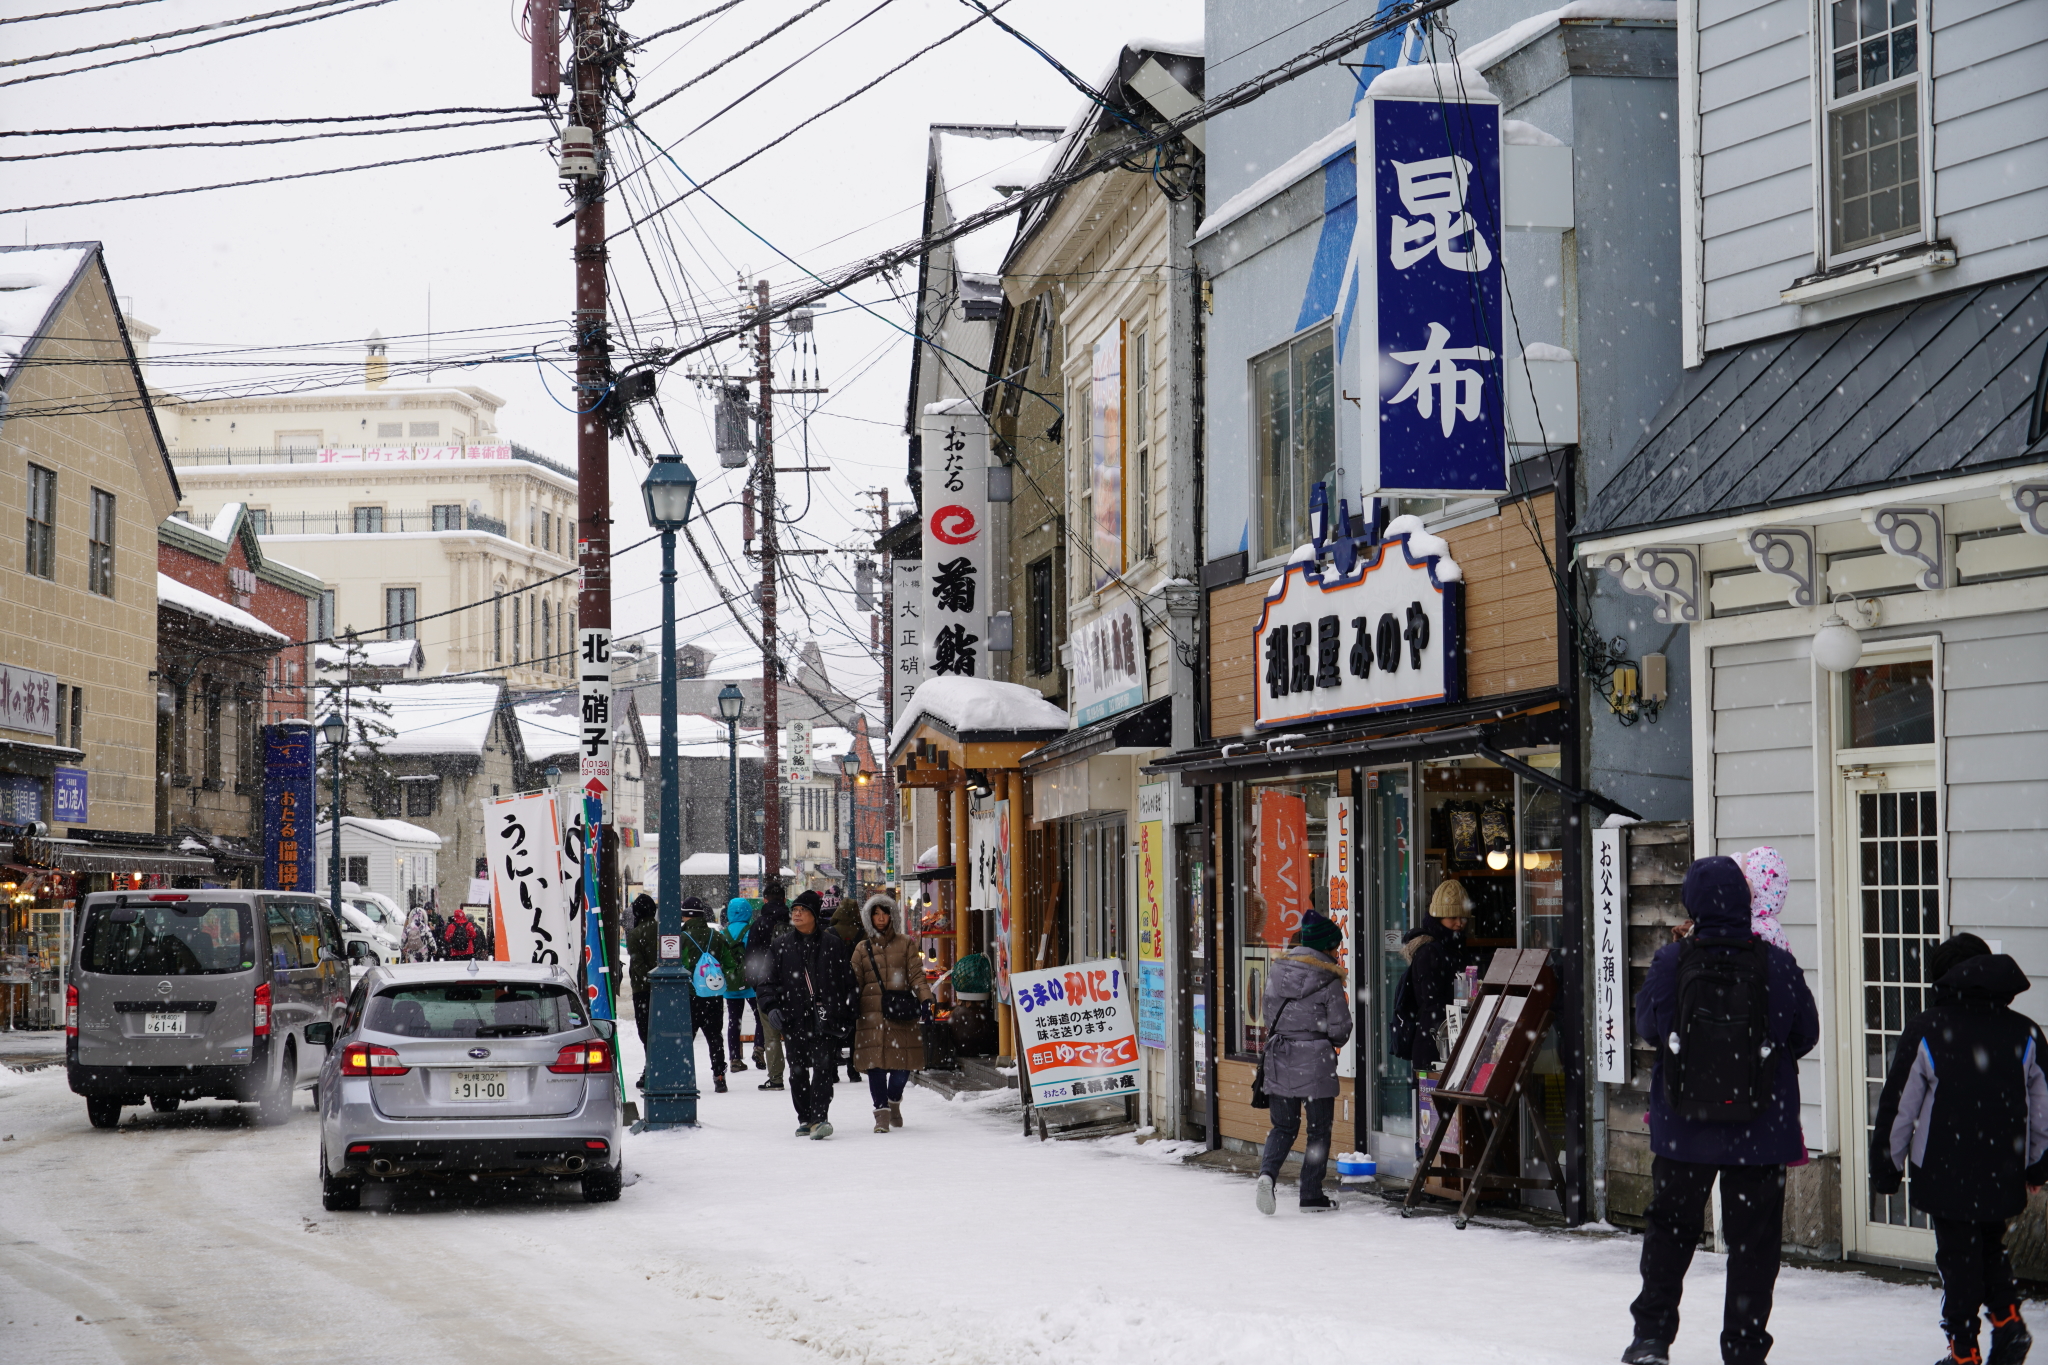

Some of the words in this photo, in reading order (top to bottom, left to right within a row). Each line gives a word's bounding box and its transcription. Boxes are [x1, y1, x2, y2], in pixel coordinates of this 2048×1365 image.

[1387, 154, 1496, 438] 昆布
[944, 425, 966, 492] おたる
[898, 580, 921, 588] 小樽
[929, 556, 979, 678] 菊鮨
[900, 600, 920, 703] 大正硝子
[1265, 614, 1342, 699] 利尻屋
[1349, 600, 1430, 680] みのや
[582, 633, 610, 757] 北一硝子
[581, 768, 610, 776] 33-1993
[586, 760, 610, 768] (0134)
[57, 786, 85, 811] 白い恋人
[1600, 840, 1617, 1072] お父さん預ります
[1035, 1006, 1117, 1028] 北海道の本物の
[1037, 1020, 1114, 1041] 味を送ります。
[463, 1082, 505, 1098] 91-00
[1043, 1087, 1068, 1099] おたる
[1071, 1074, 1136, 1096] 高橋水産
